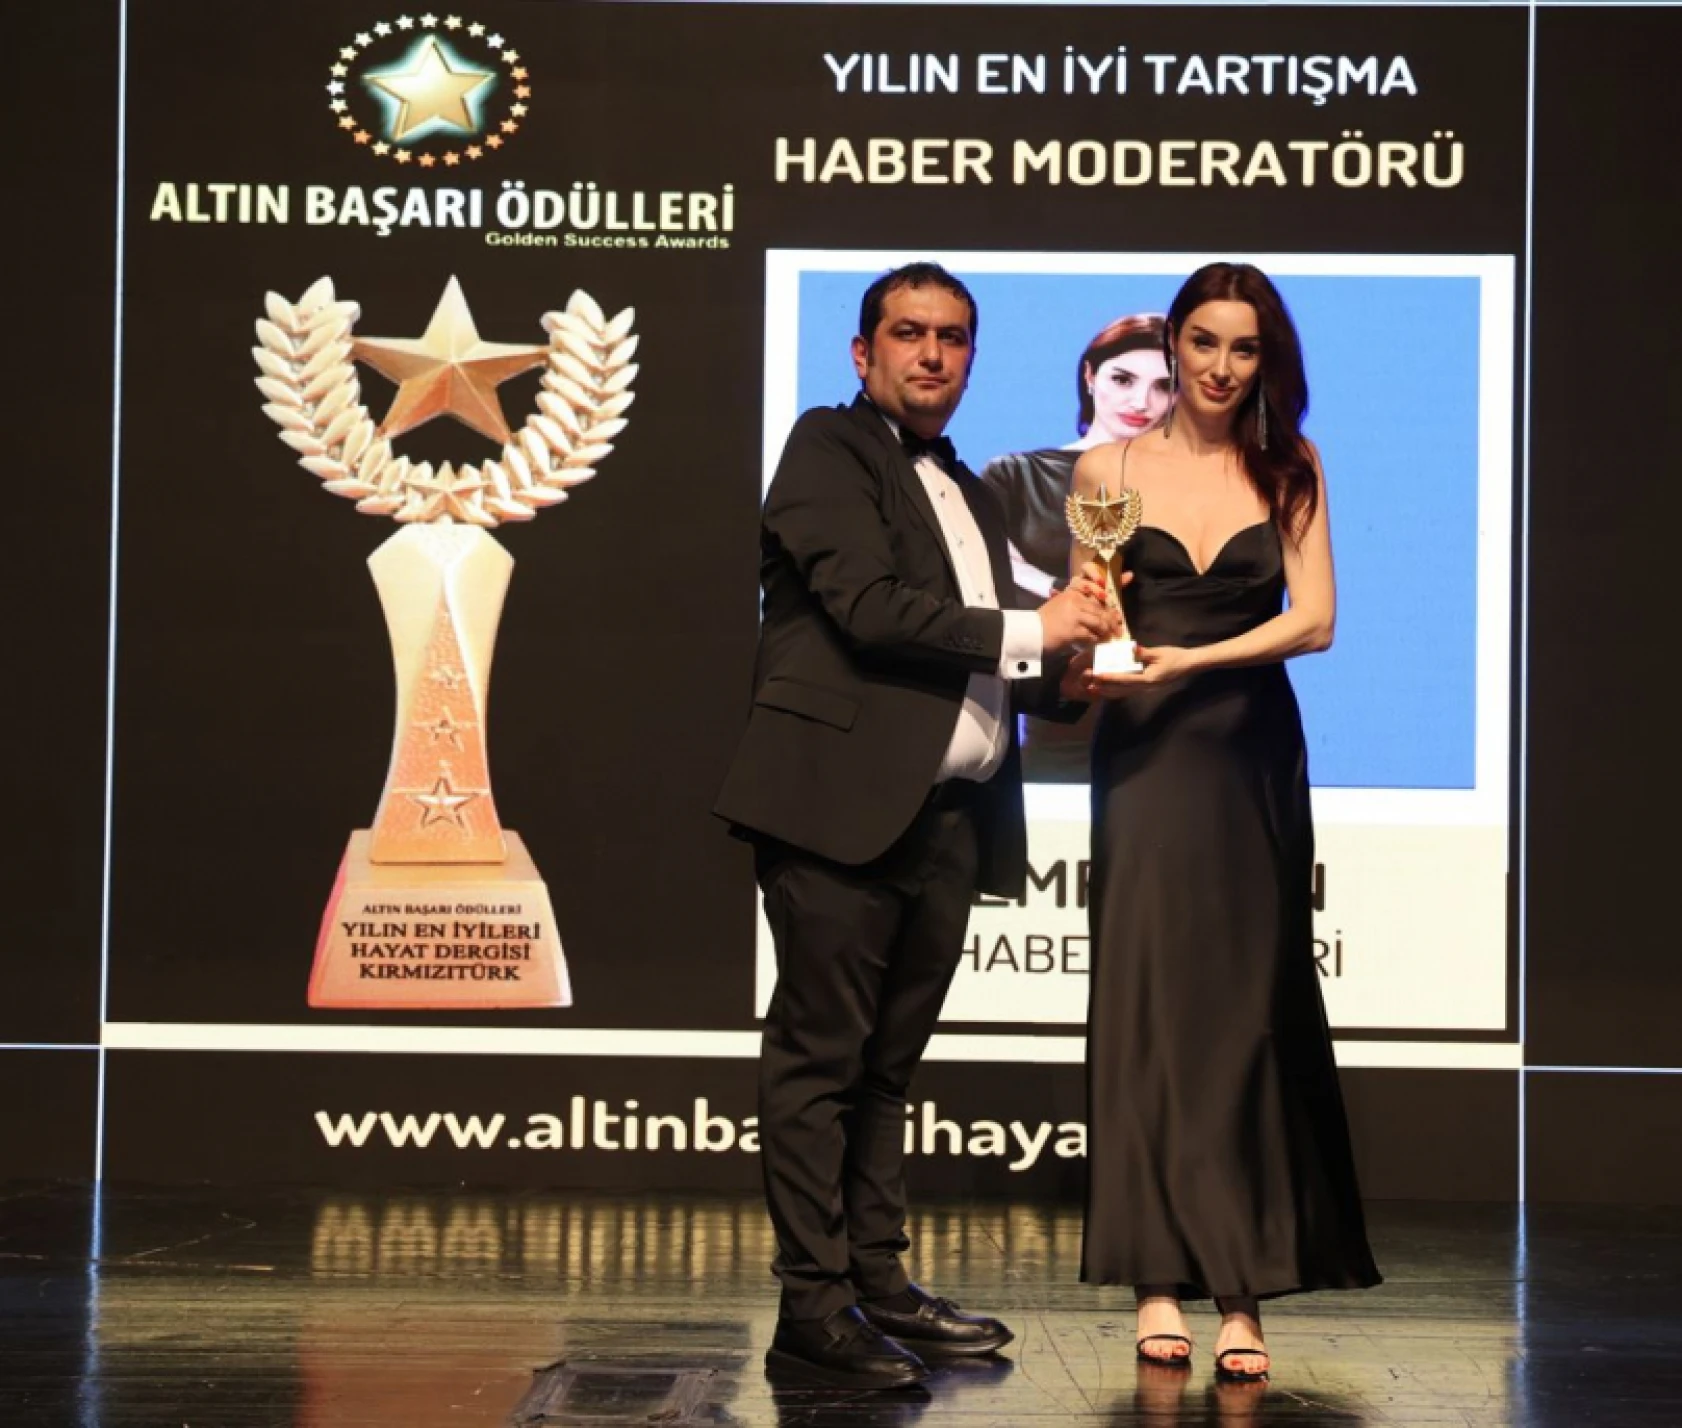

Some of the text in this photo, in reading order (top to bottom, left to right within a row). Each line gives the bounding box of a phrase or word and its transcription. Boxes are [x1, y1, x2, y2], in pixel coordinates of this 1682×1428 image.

[824, 46, 1418, 106] YILIN EN İYİ TARTIŞMA
[774, 131, 1464, 187] HABER MODERATÖRÜ
[150, 180, 734, 237] ALTIN BAŞARI ÖDÜLLERİ
[484, 231, 730, 249] Golden Success Awards
[363, 904, 401, 915] ALTIN
[404, 904, 452, 916] BAŞARI
[342, 921, 540, 940] YILIN EN İYİLERİ
[351, 942, 531, 961] HAYAT DERGİSİ
[962, 934, 1090, 974] HABE
[359, 962, 521, 981] KIRMIZITÜRK
